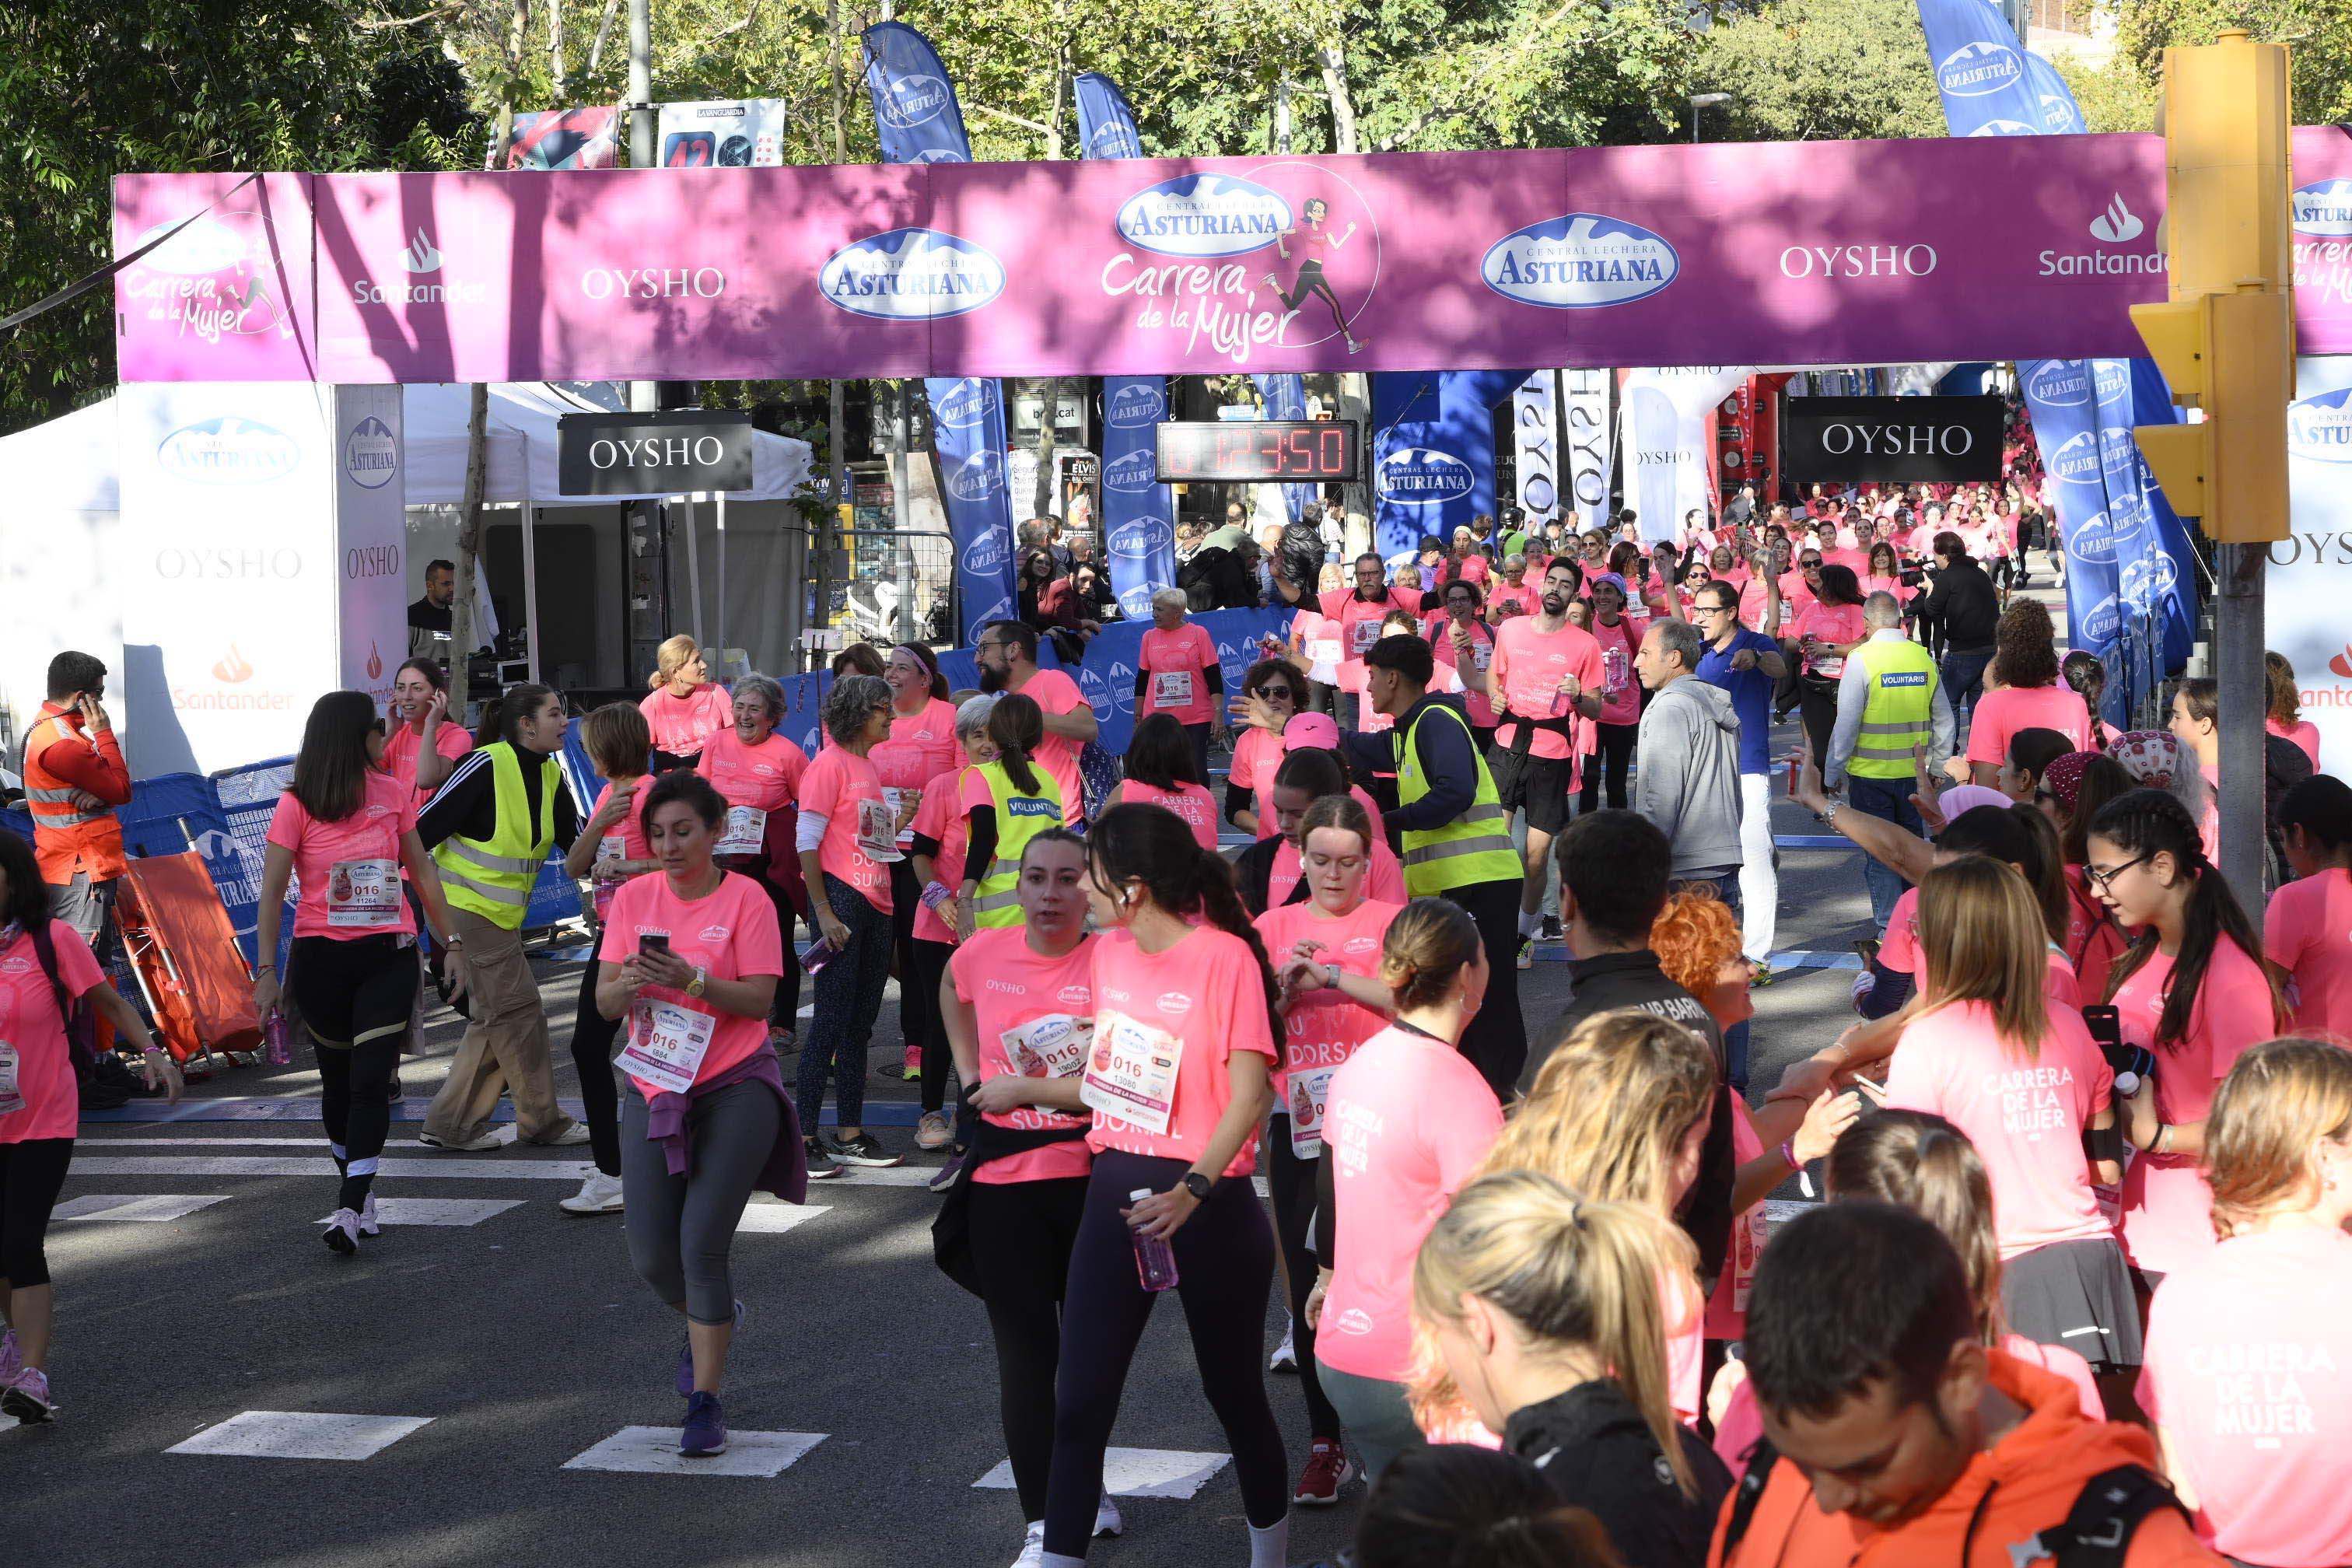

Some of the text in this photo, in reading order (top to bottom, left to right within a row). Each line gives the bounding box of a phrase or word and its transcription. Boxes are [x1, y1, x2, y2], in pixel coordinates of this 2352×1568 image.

[706, 107, 744, 116] VANGUARDIA
[1130, 205, 1278, 236] ASTURIANA
[1527, 243, 1657, 256] CENTRAL LECHERA
[1780, 243, 1937, 278] OYSHO
[1496, 250, 1663, 284] ASTURIANA
[2039, 250, 2170, 275] Santand
[124, 269, 216, 299] Carrera
[583, 267, 725, 299] OYSHO
[833, 263, 991, 296] ASTURIANA
[1101, 254, 1247, 296] Carrera
[355, 281, 486, 304] Santander
[179, 296, 252, 344] Mujer
[1137, 291, 1300, 363] de la Mujer
[1822, 424, 1972, 456] OYSHO
[349, 443, 394, 471] ASTURIANA
[589, 436, 723, 468] OYSHO
[1633, 451, 1691, 465] OYSHO
[1014, 465, 1038, 477] Segur
[1073, 464, 1096, 473] ELVIS
[1380, 471, 1467, 492] ASTURIANA
[156, 548, 302, 579] OYSHO
[348, 544, 398, 579] OYSHO
[1882, 675, 1925, 684] VOLUNTARIS
[174, 689, 293, 710] Santander
[355, 886, 379, 894] 016
[852, 873, 888, 887] SUMA
[635, 925, 672, 936] OYSHO
[986, 979, 1026, 995] OYSHO
[653, 1033, 677, 1050] 016
[1047, 1044, 1079, 1064] 016
[624, 1059, 648, 1073] OYSHO
[1058, 1059, 1081, 1073] 19002
[1114, 1056, 1142, 1076] 016
[1115, 1075, 1136, 1089] 13080
[1984, 1066, 2074, 1095] CARRERA
[2002, 1092, 2060, 1114] DE LA
[2003, 1110, 2066, 1133] MUJER
[1300, 1143, 1321, 1153] OYSH
[2189, 1342, 2336, 1374] CARRERA
[2215, 1373, 2259, 1403] DE
